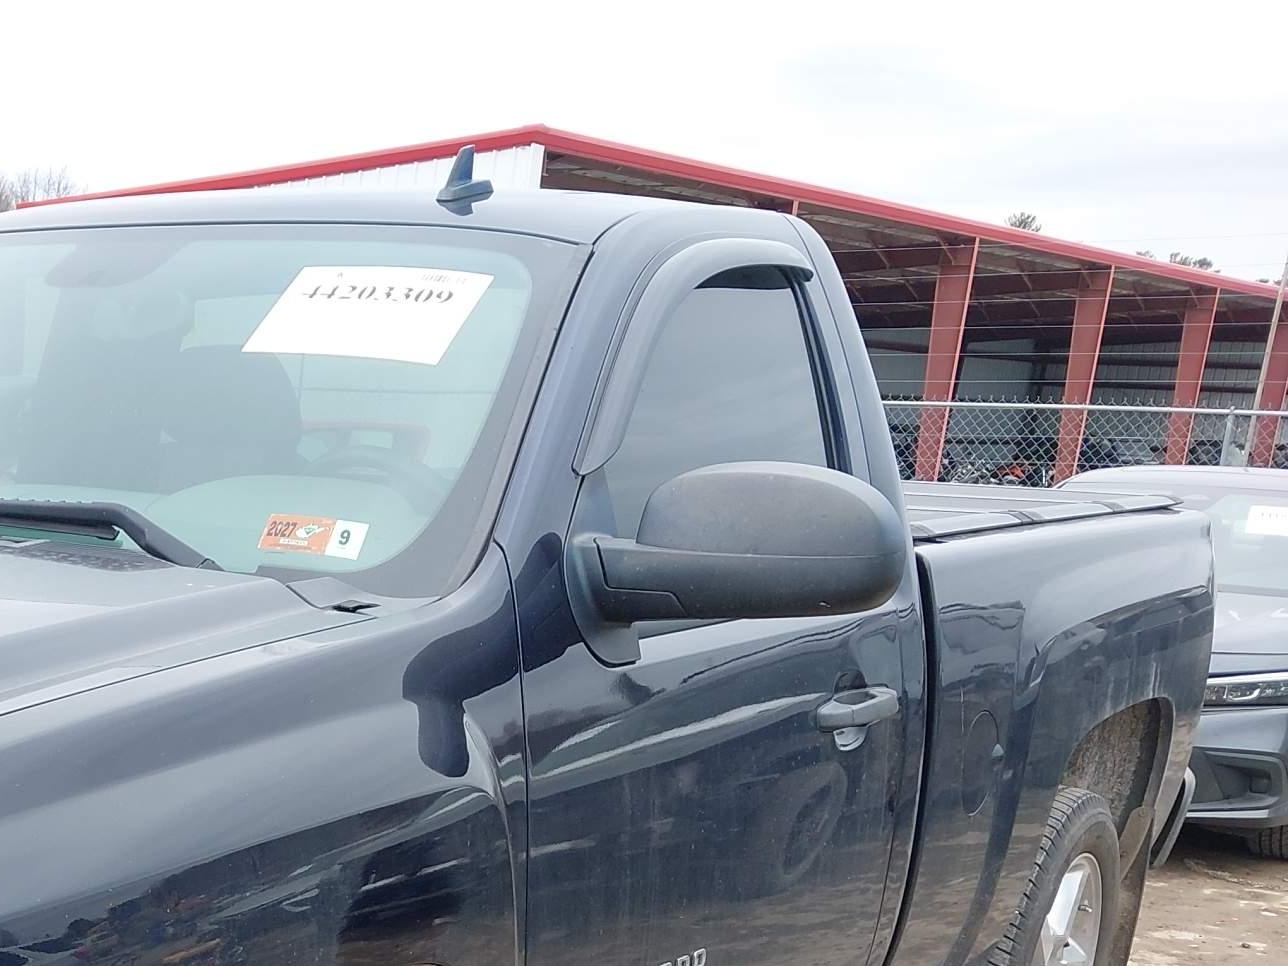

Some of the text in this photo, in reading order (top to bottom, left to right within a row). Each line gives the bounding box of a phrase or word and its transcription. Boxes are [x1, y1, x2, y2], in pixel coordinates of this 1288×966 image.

[303, 285, 454, 302] 44203309
[266, 520, 298, 538] 2027
[339, 530, 351, 545] 9
